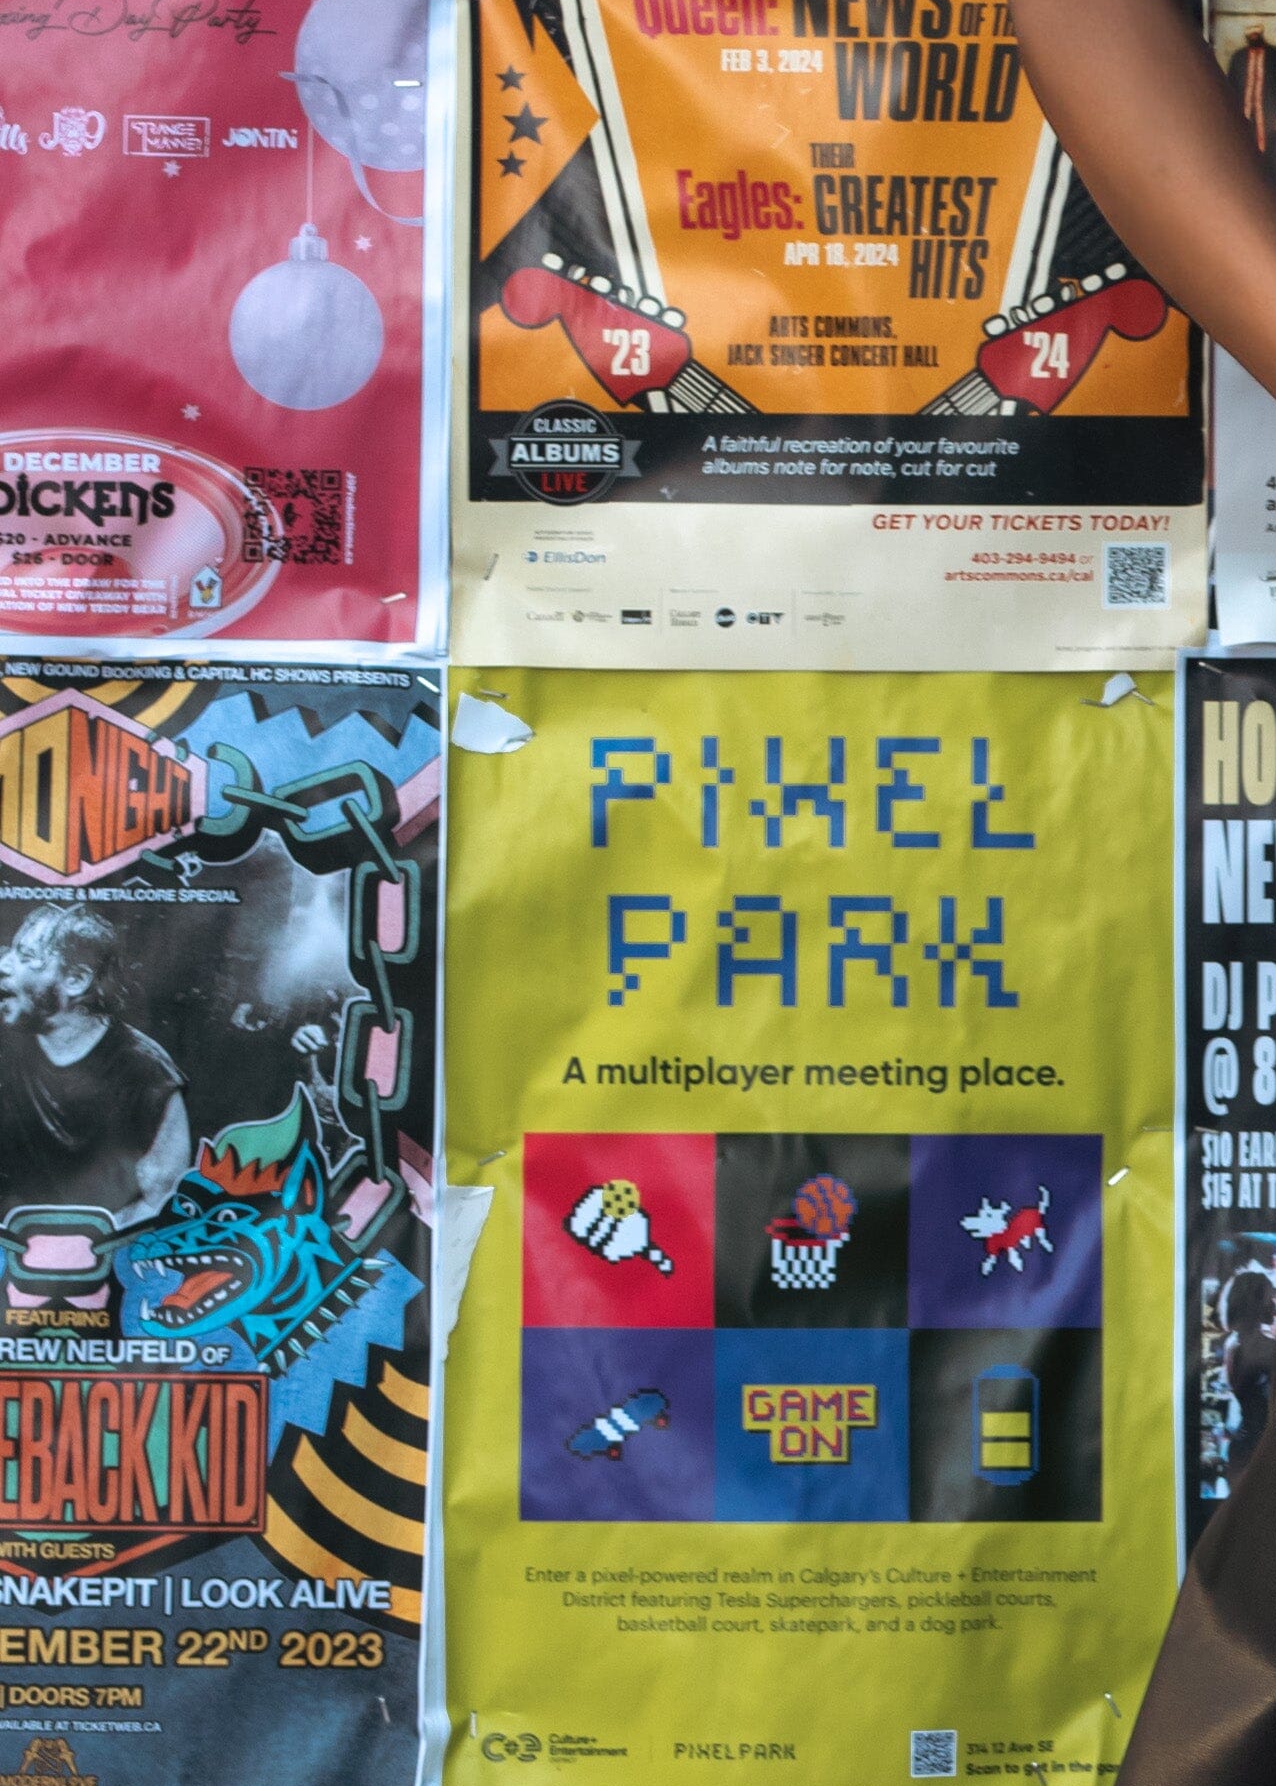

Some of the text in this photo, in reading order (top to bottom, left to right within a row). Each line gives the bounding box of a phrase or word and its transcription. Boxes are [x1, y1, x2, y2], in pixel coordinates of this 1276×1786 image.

[834, 41, 1021, 122] WORLD
[810, 142, 856, 169] THEIR
[677, 168, 998, 240] Eagles: GREATEST
[907, 239, 991, 300] HITS
[534, 418, 596, 434] CLASSIC
[4, 452, 161, 473] DECEMBER
[511, 440, 621, 465] ALBUMS
[541, 472, 588, 494] LIVE
[872, 515, 1170, 532] GET YOUR TICKETS TODAY!
[971, 552, 1077, 566] 403-294-9494
[944, 568, 1094, 584] artscommons.ca/cal
[334, 671, 411, 687] PRESENTS
[590, 735, 1035, 849] PIXEL
[608, 894, 1019, 1009] PARK
[562, 1057, 1065, 1093] A multiplayer meeting place.
[66, 1341, 230, 1365] NEUFELD OF
[747, 1390, 873, 1423] GAME
[170, 1385, 260, 1525] KID
[778, 1426, 843, 1458] ON
[181, 1578, 391, 1609] LOOK ALIVE
[279, 1632, 384, 1668] 2023
[9, 1687, 142, 1707] DOORS 7PM
